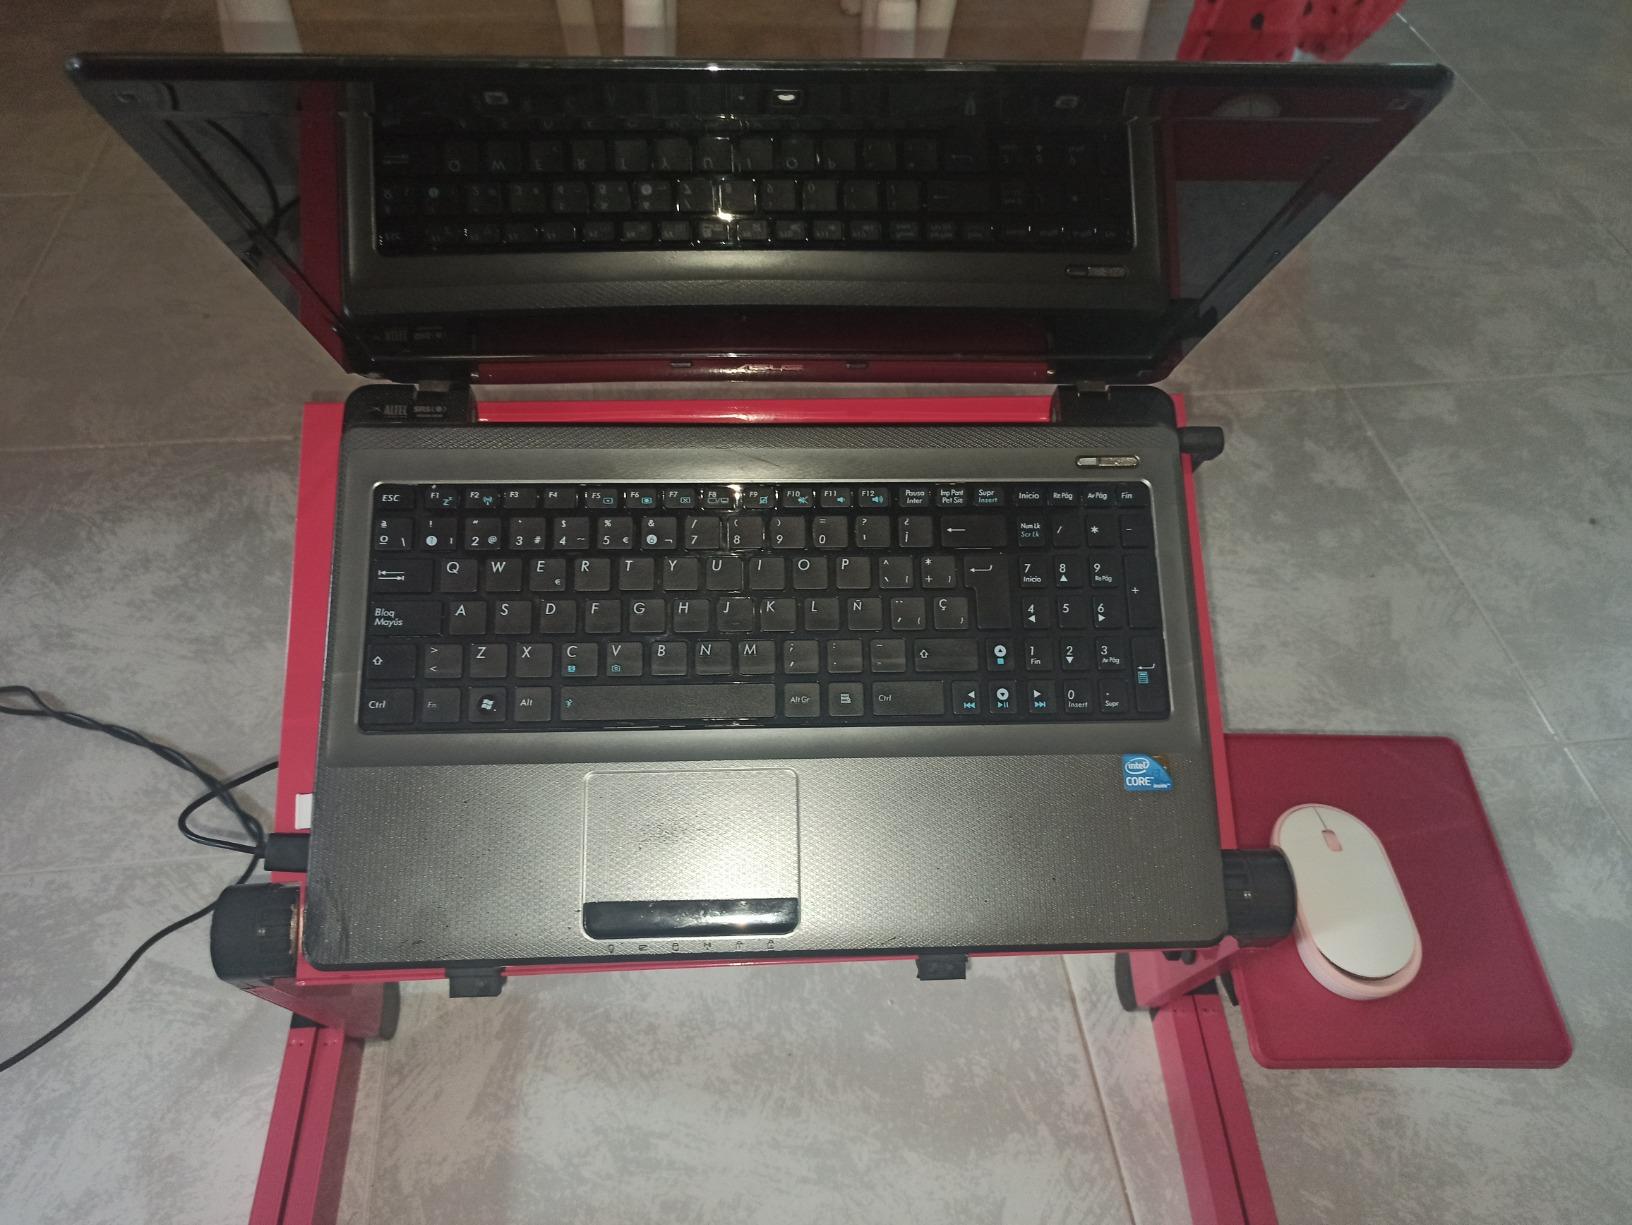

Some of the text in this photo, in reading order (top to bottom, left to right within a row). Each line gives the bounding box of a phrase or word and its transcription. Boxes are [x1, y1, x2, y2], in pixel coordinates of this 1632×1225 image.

[692, 520, 697, 528] /
[472, 537, 479, 546] 2
[488, 536, 497, 544] @
[516, 536, 523, 545] 3
[560, 536, 566, 545] 4
[603, 536, 610, 544] 5
[691, 536, 698, 544] 7
[734, 535, 740, 544] 8
[776, 535, 783, 543] 9
[819, 535, 826, 543] 0
[446, 562, 459, 574] Q
[491, 562, 506, 573] W
[536, 560, 545, 572] E
[581, 561, 589, 572] R
[625, 560, 633, 571] T
[669, 560, 677, 571] Y
[712, 560, 722, 570] U
[798, 559, 810, 570] O
[841, 559, 849, 569] P
[1025, 564, 1031, 573] 7
[1060, 564, 1066, 573] 8
[1094, 564, 1100, 573] 9
[500, 604, 510, 615] S
[546, 603, 556, 614] D
[591, 603, 599, 614] F
[634, 603, 645, 614] G
[678, 602, 689, 613] H
[723, 602, 730, 613] J
[766, 601, 775, 612] K
[811, 601, 817, 612] L
[853, 600, 862, 611] Ñ
[939, 599, 947, 610] Ç
[1028, 604, 1034, 613] 4
[1062, 604, 1070, 612] 5
[1098, 603, 1104, 612] 6
[375, 608, 394, 618] Bloq
[455, 605, 466, 616] A
[476, 647, 486, 659] Z
[522, 647, 532, 658] X
[567, 646, 578, 658] C
[612, 645, 621, 656] V
[658, 645, 666, 656] B
[700, 644, 711, 656] N
[744, 644, 756, 655] M
[1030, 646, 1034, 655] 1
[1066, 646, 1073, 655] 2
[1101, 646, 1108, 655] 3
[1068, 690, 1074, 699] 0
[1126, 776, 1152, 786] CORE
